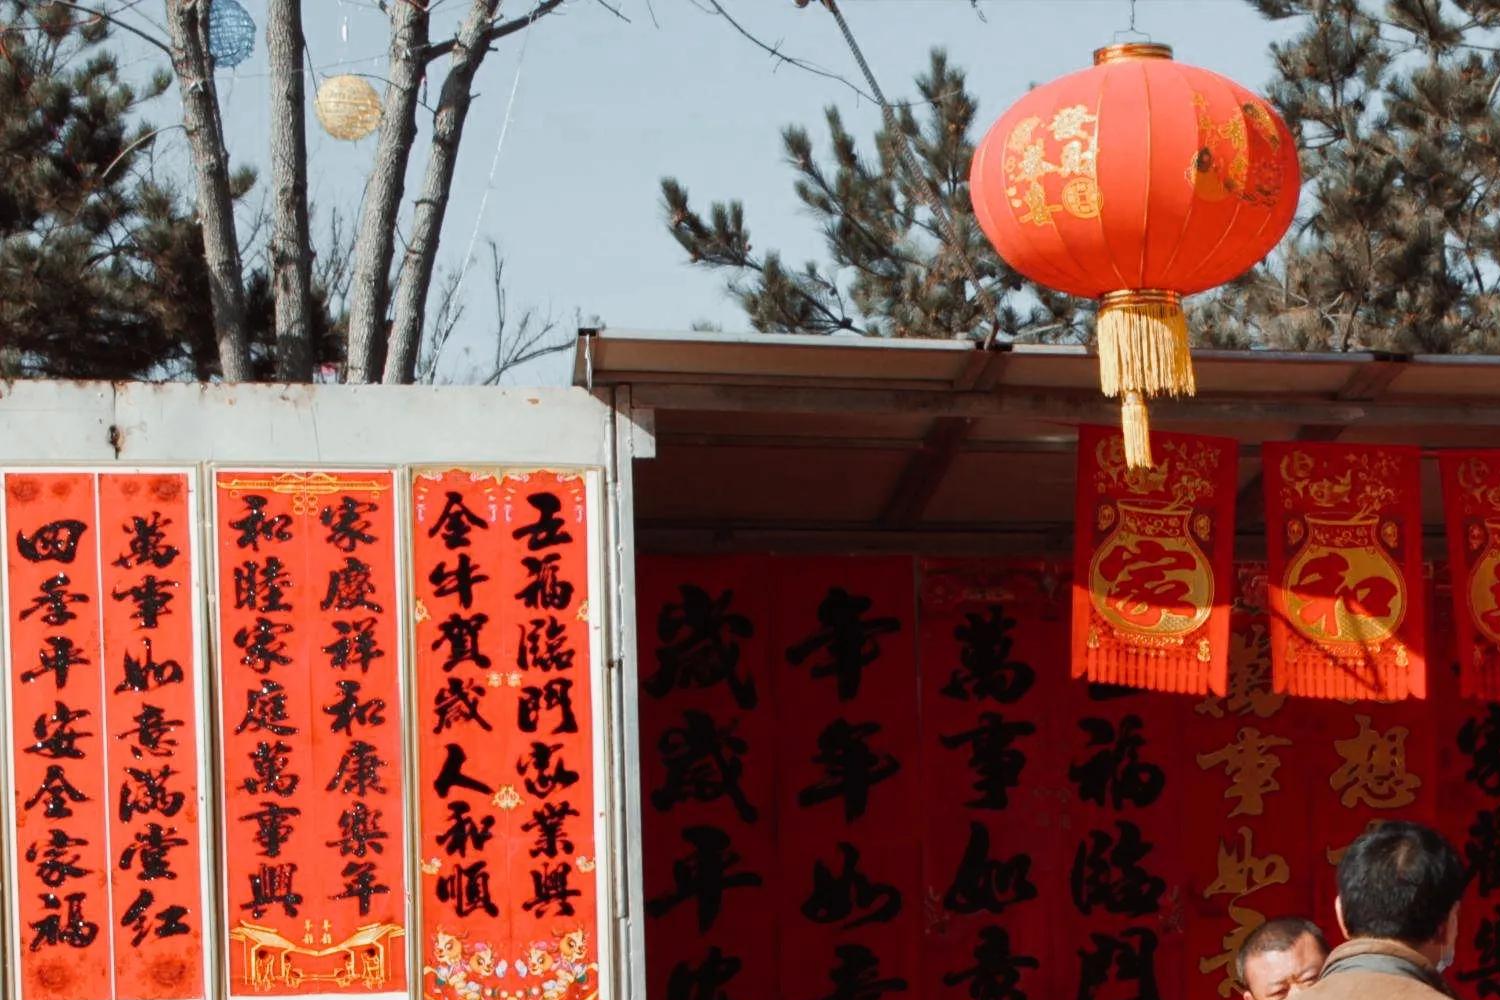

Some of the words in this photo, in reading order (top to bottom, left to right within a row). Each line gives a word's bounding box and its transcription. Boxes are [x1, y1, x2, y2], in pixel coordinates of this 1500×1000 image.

[17, 519, 98, 952] 四季平安全家福
[233, 496, 303, 919] 和睦家庭萬事興
[1290, 552, 1399, 639] 和
